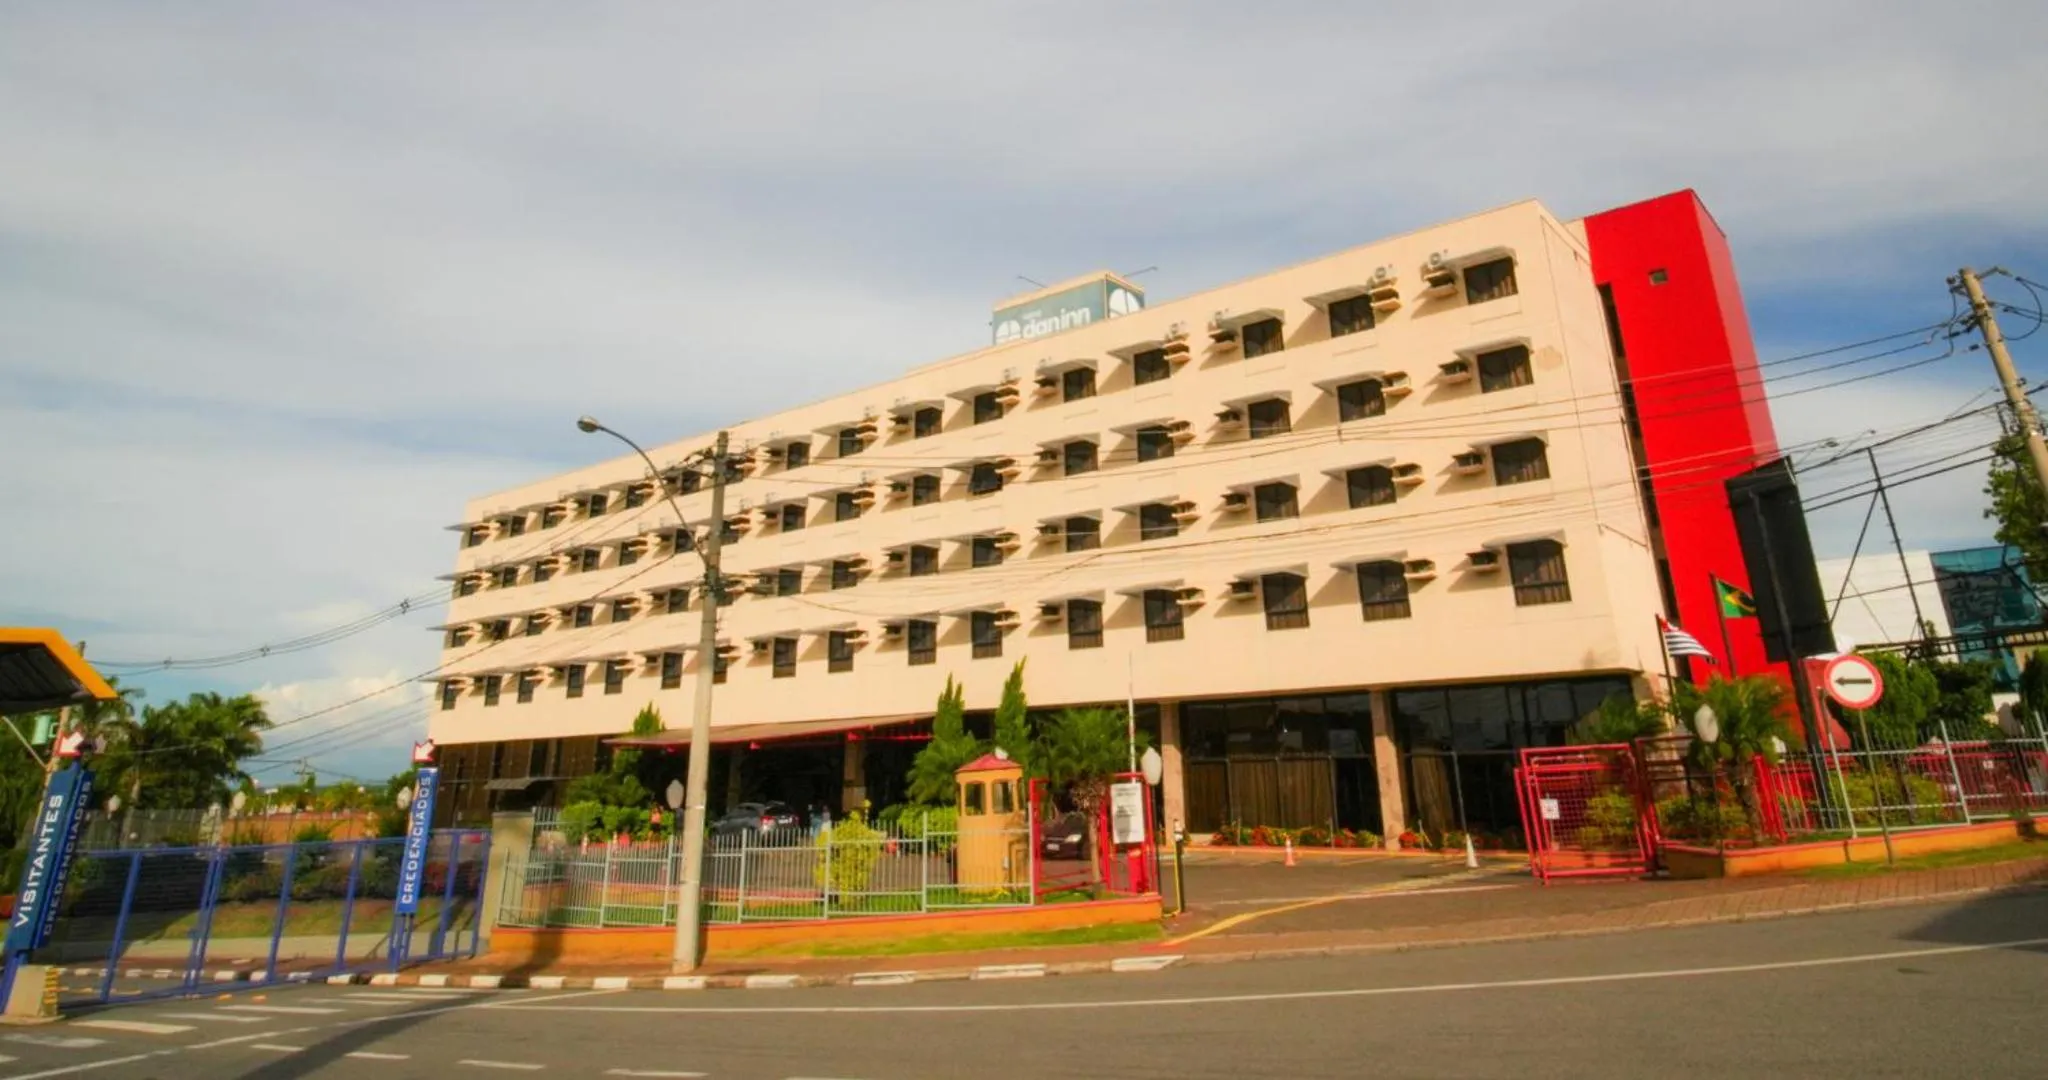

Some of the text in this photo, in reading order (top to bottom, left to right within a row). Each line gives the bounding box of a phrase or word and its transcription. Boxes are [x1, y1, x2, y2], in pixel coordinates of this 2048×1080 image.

[14, 794, 63, 928] VISITANTES
[44, 780, 92, 936] CREDENCIADOS
[402, 776, 432, 904] CREDENCIADOS
